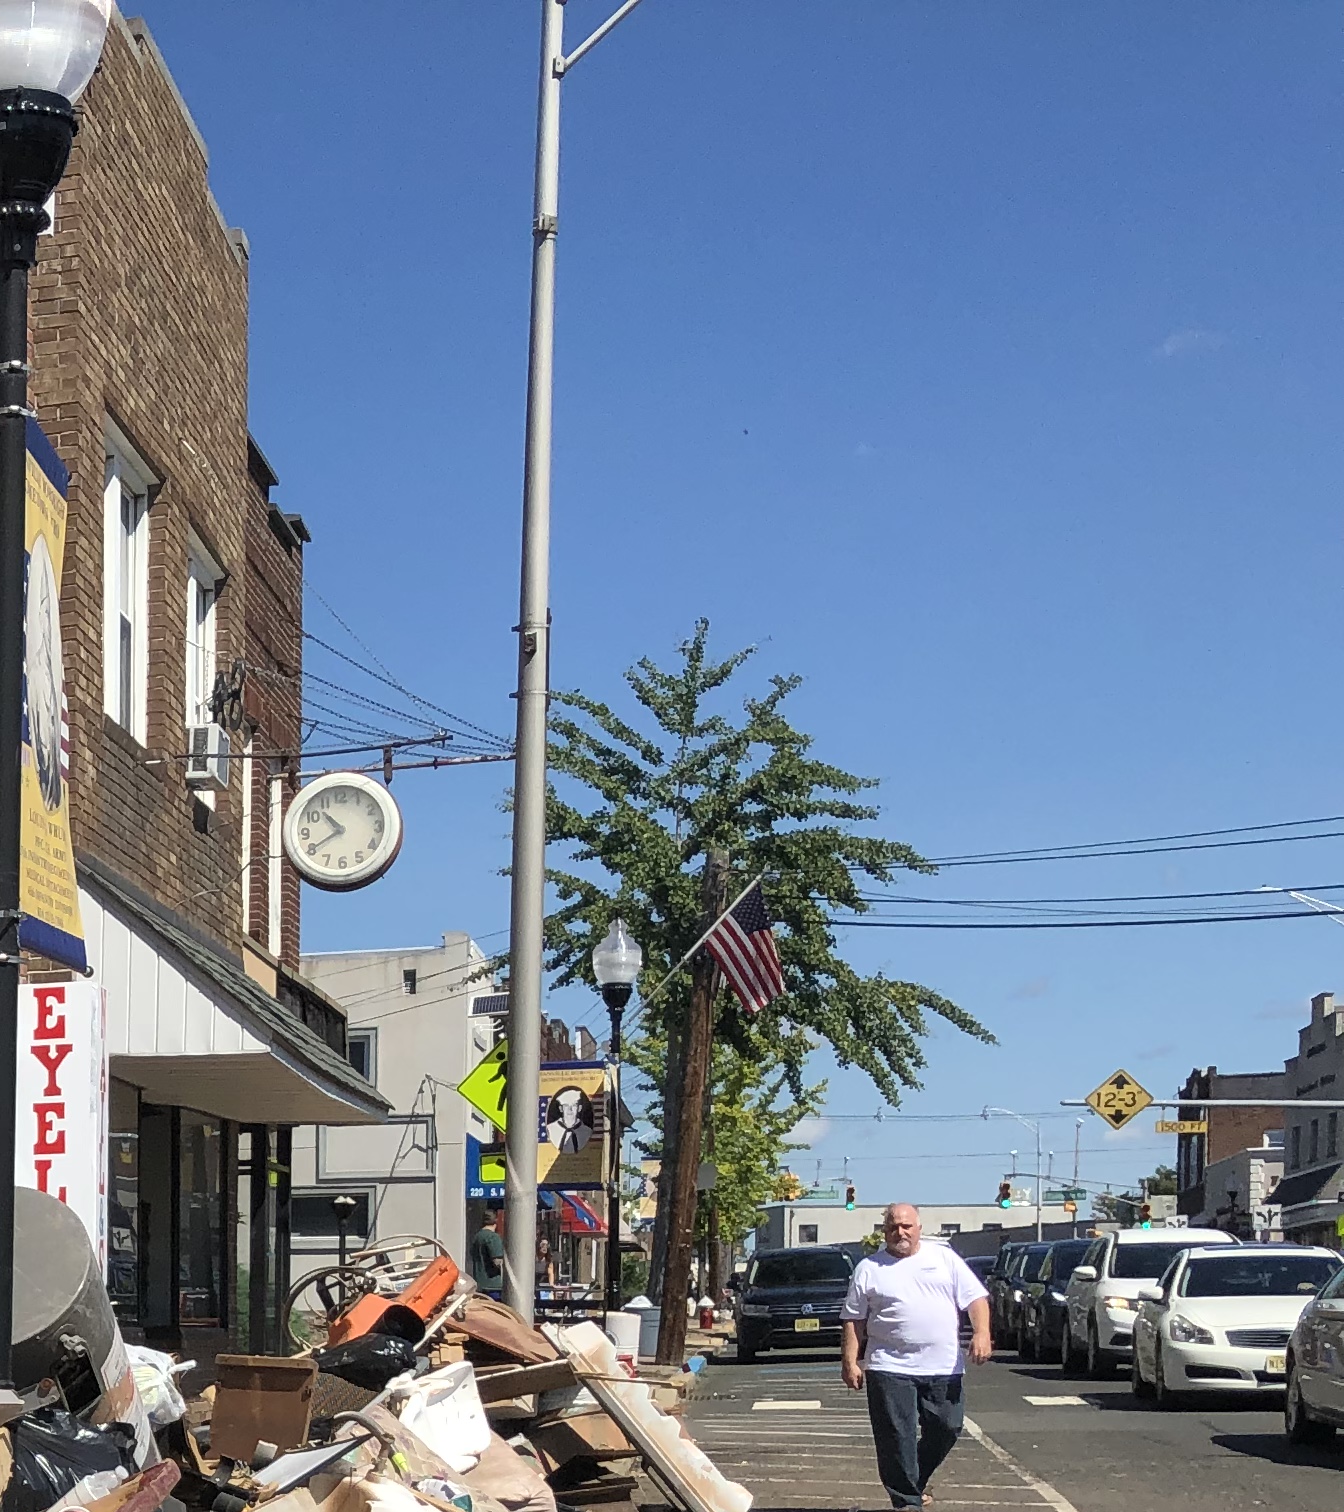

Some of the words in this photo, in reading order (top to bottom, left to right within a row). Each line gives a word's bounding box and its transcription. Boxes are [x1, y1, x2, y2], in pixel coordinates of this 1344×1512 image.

[320, 797, 330, 810] 11
[334, 791, 348, 804] 12
[355, 791, 361, 806] 1
[365, 803, 376, 816] 2
[306, 810, 321, 824] 10
[374, 820, 383, 834] 3
[300, 827, 311, 841] 9
[322, 854, 331, 867] 7
[338, 856, 348, 869] 6
[355, 851, 364, 864] 5
[29, 986, 74, 1204] EYEL
[470, 1187, 484, 1197] 220
